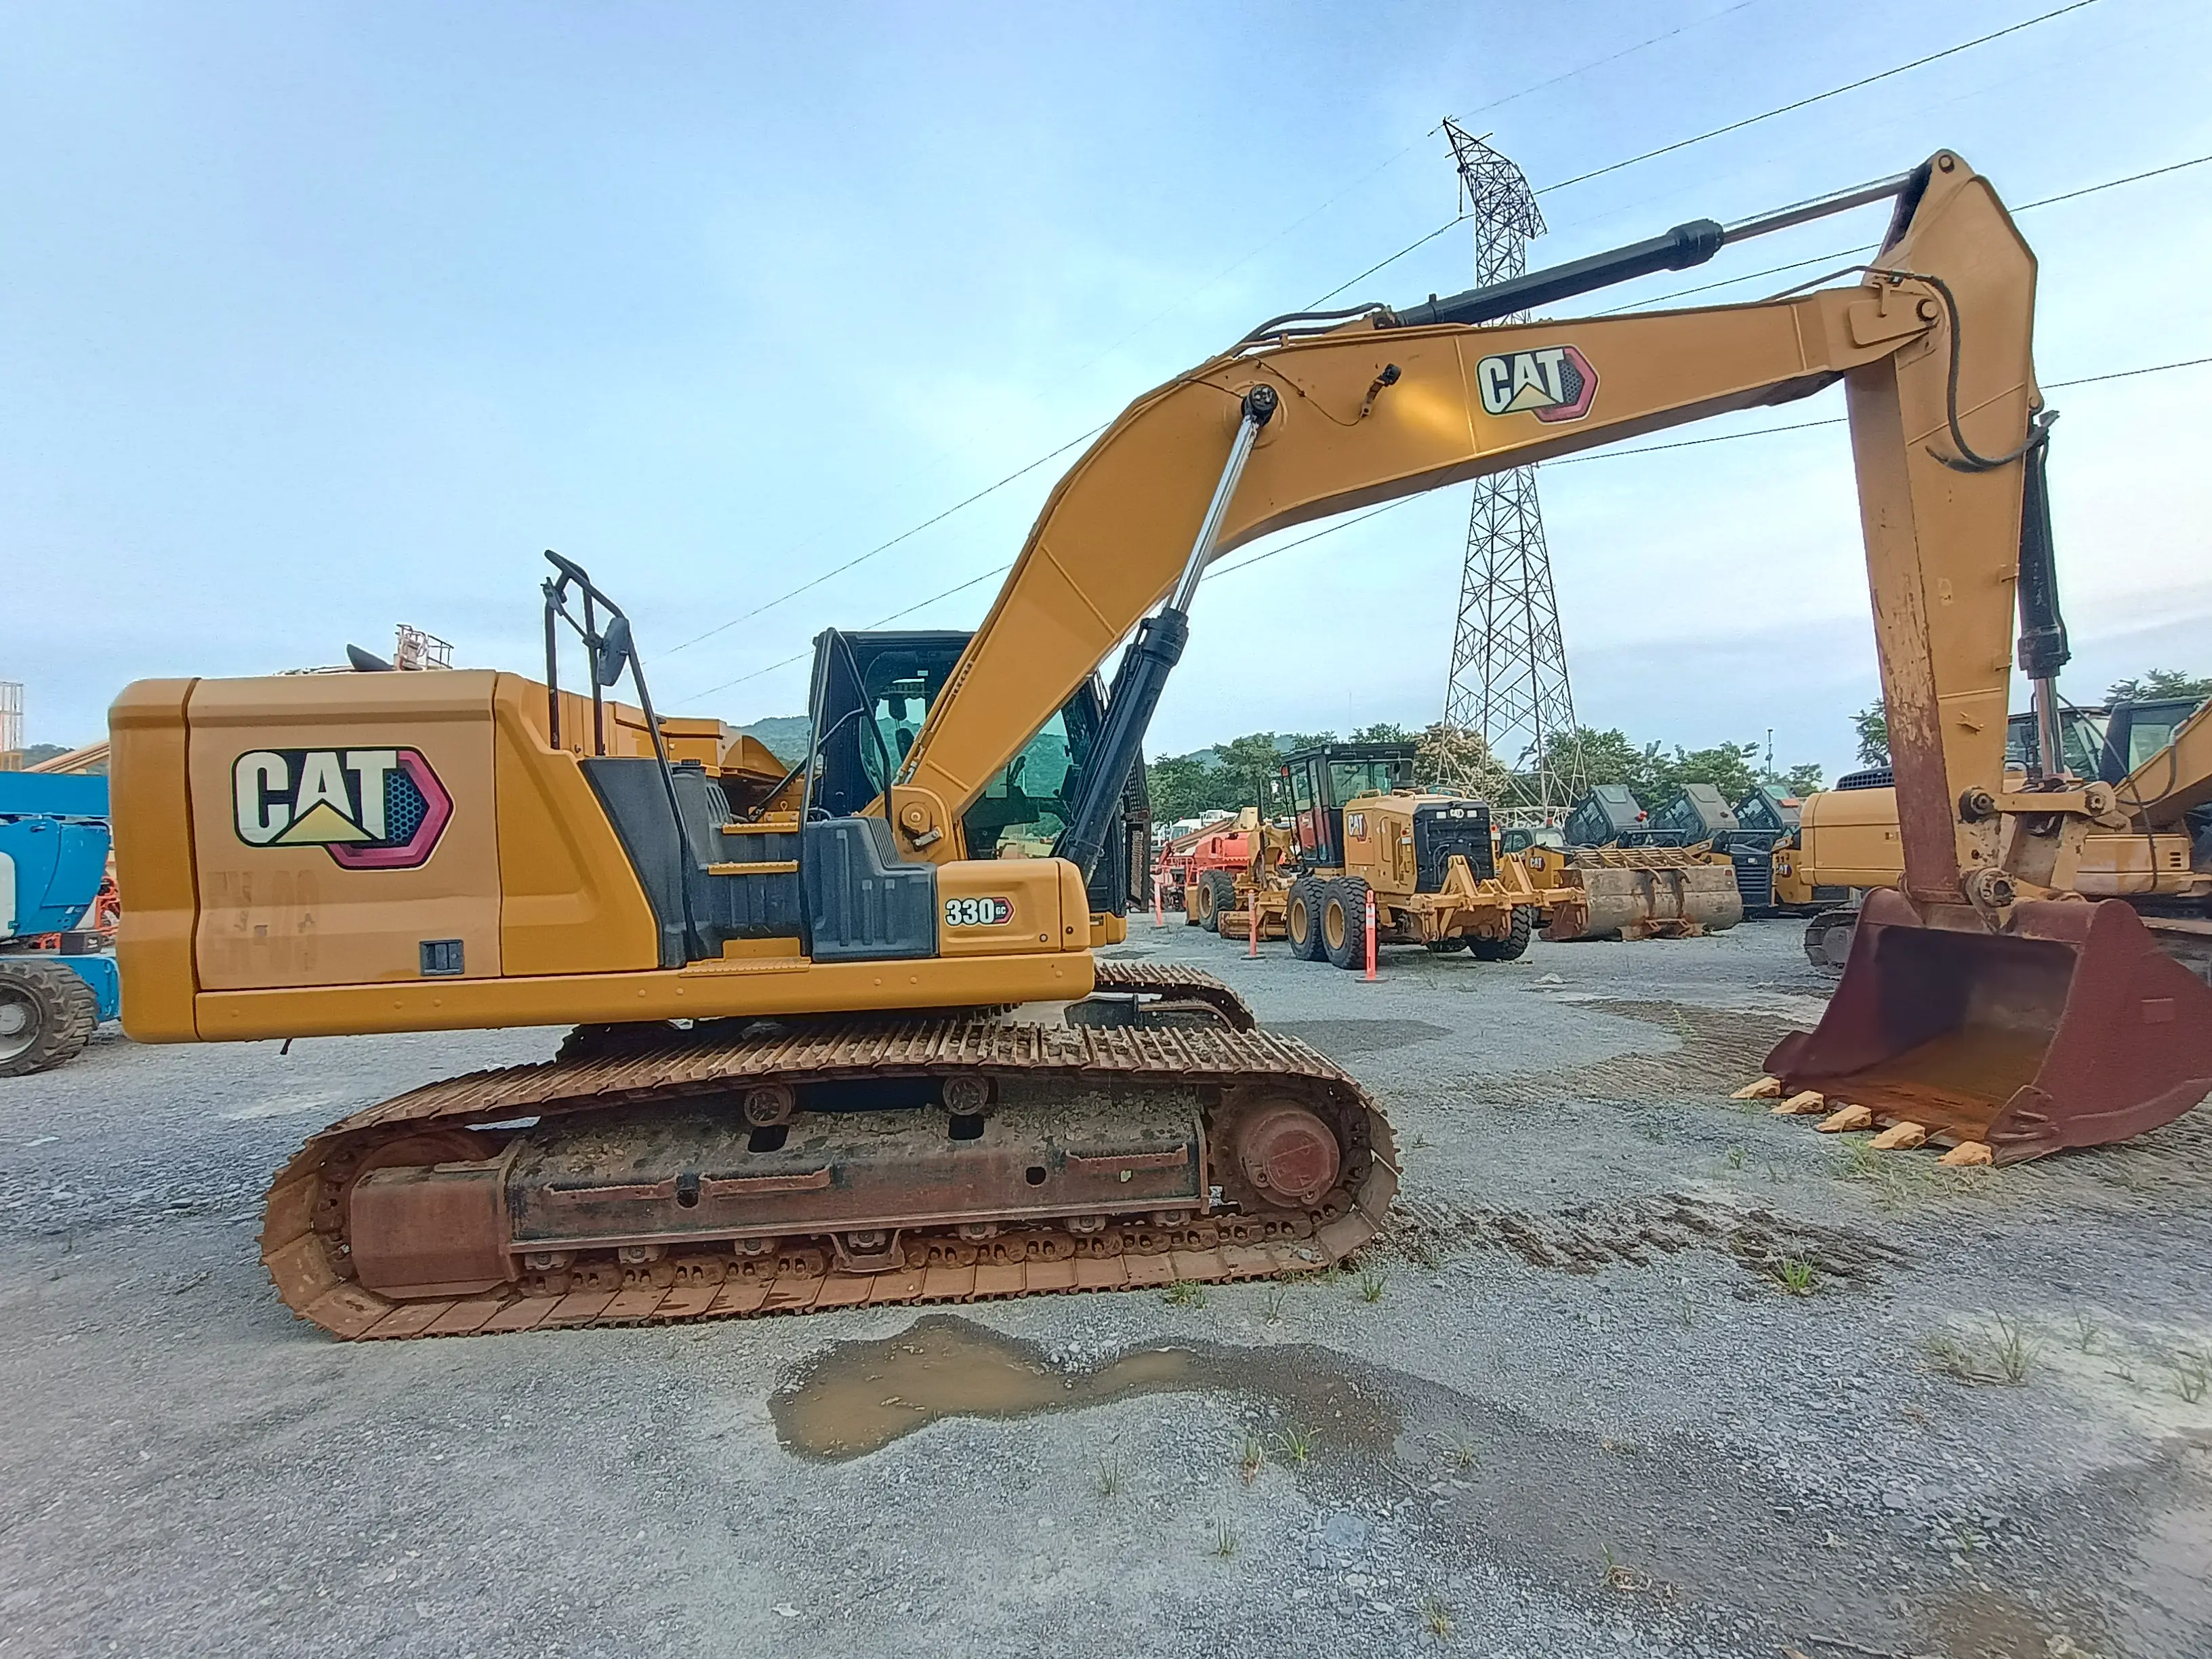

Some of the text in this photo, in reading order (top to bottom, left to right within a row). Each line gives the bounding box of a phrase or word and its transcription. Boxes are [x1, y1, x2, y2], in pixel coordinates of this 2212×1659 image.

[1479, 348, 1564, 413] CAT
[236, 751, 398, 844] CAT
[1349, 813, 1364, 836] CAT
[1530, 857, 1542, 868] CAT
[945, 898, 1006, 926] 330 GC
